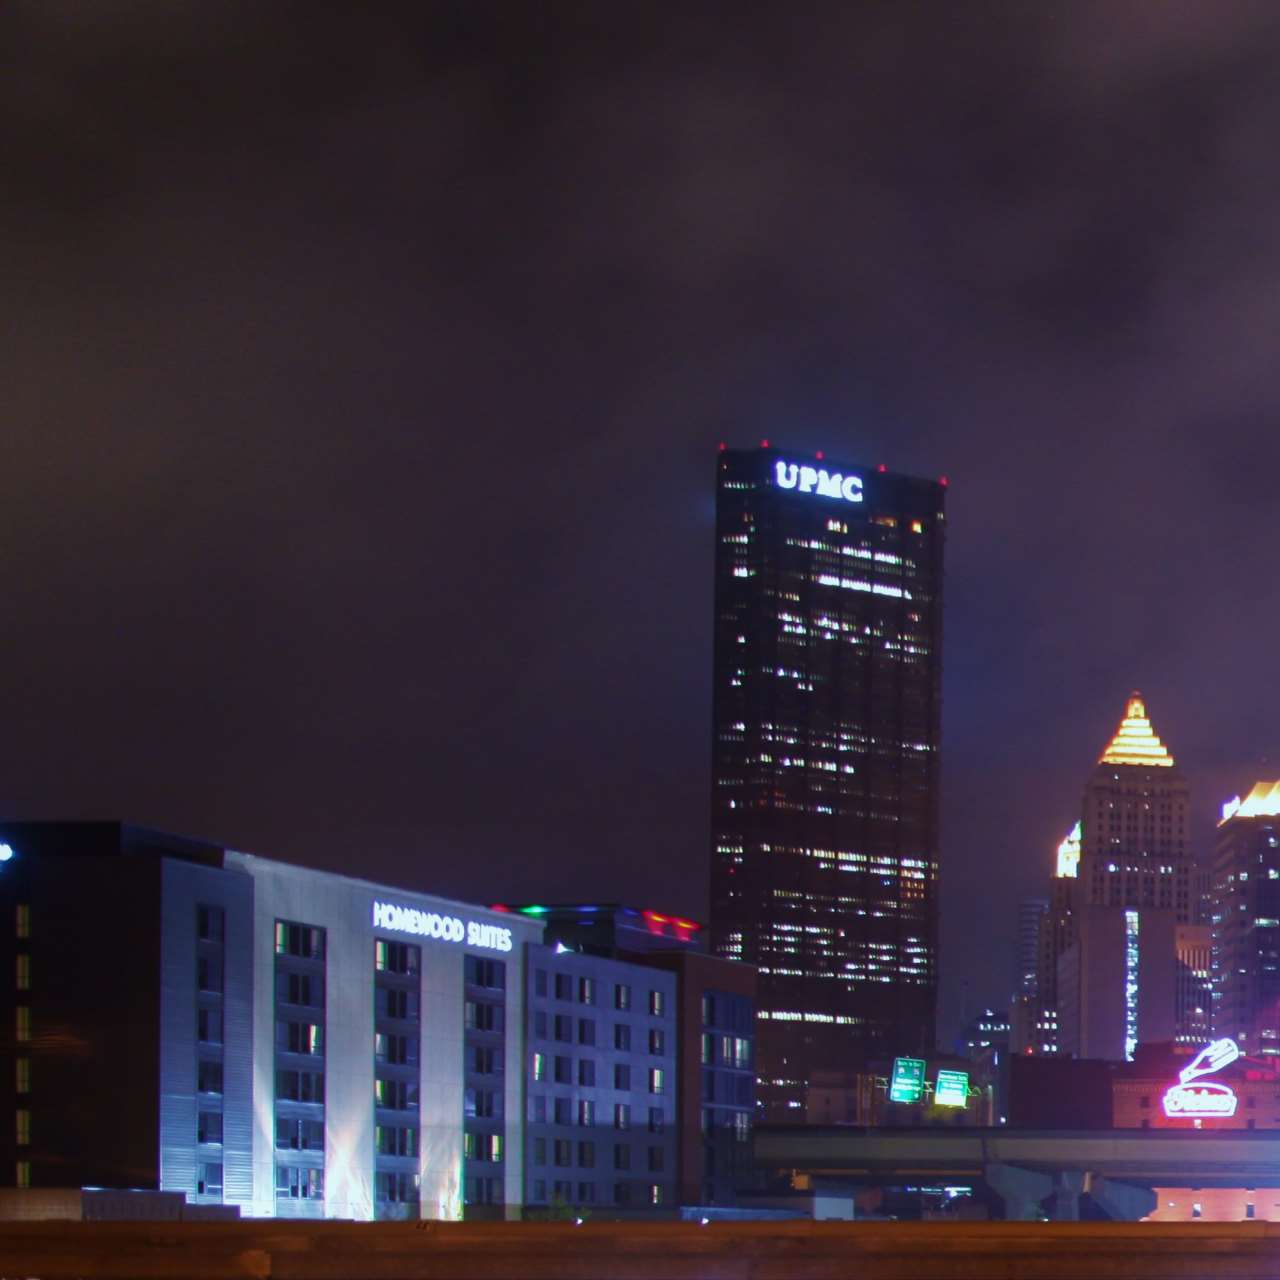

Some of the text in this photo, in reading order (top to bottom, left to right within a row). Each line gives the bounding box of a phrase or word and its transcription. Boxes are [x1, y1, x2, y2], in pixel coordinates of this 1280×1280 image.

[776, 461, 863, 502] UPMC
[373, 901, 512, 952] HOMEWOOD SUITES
